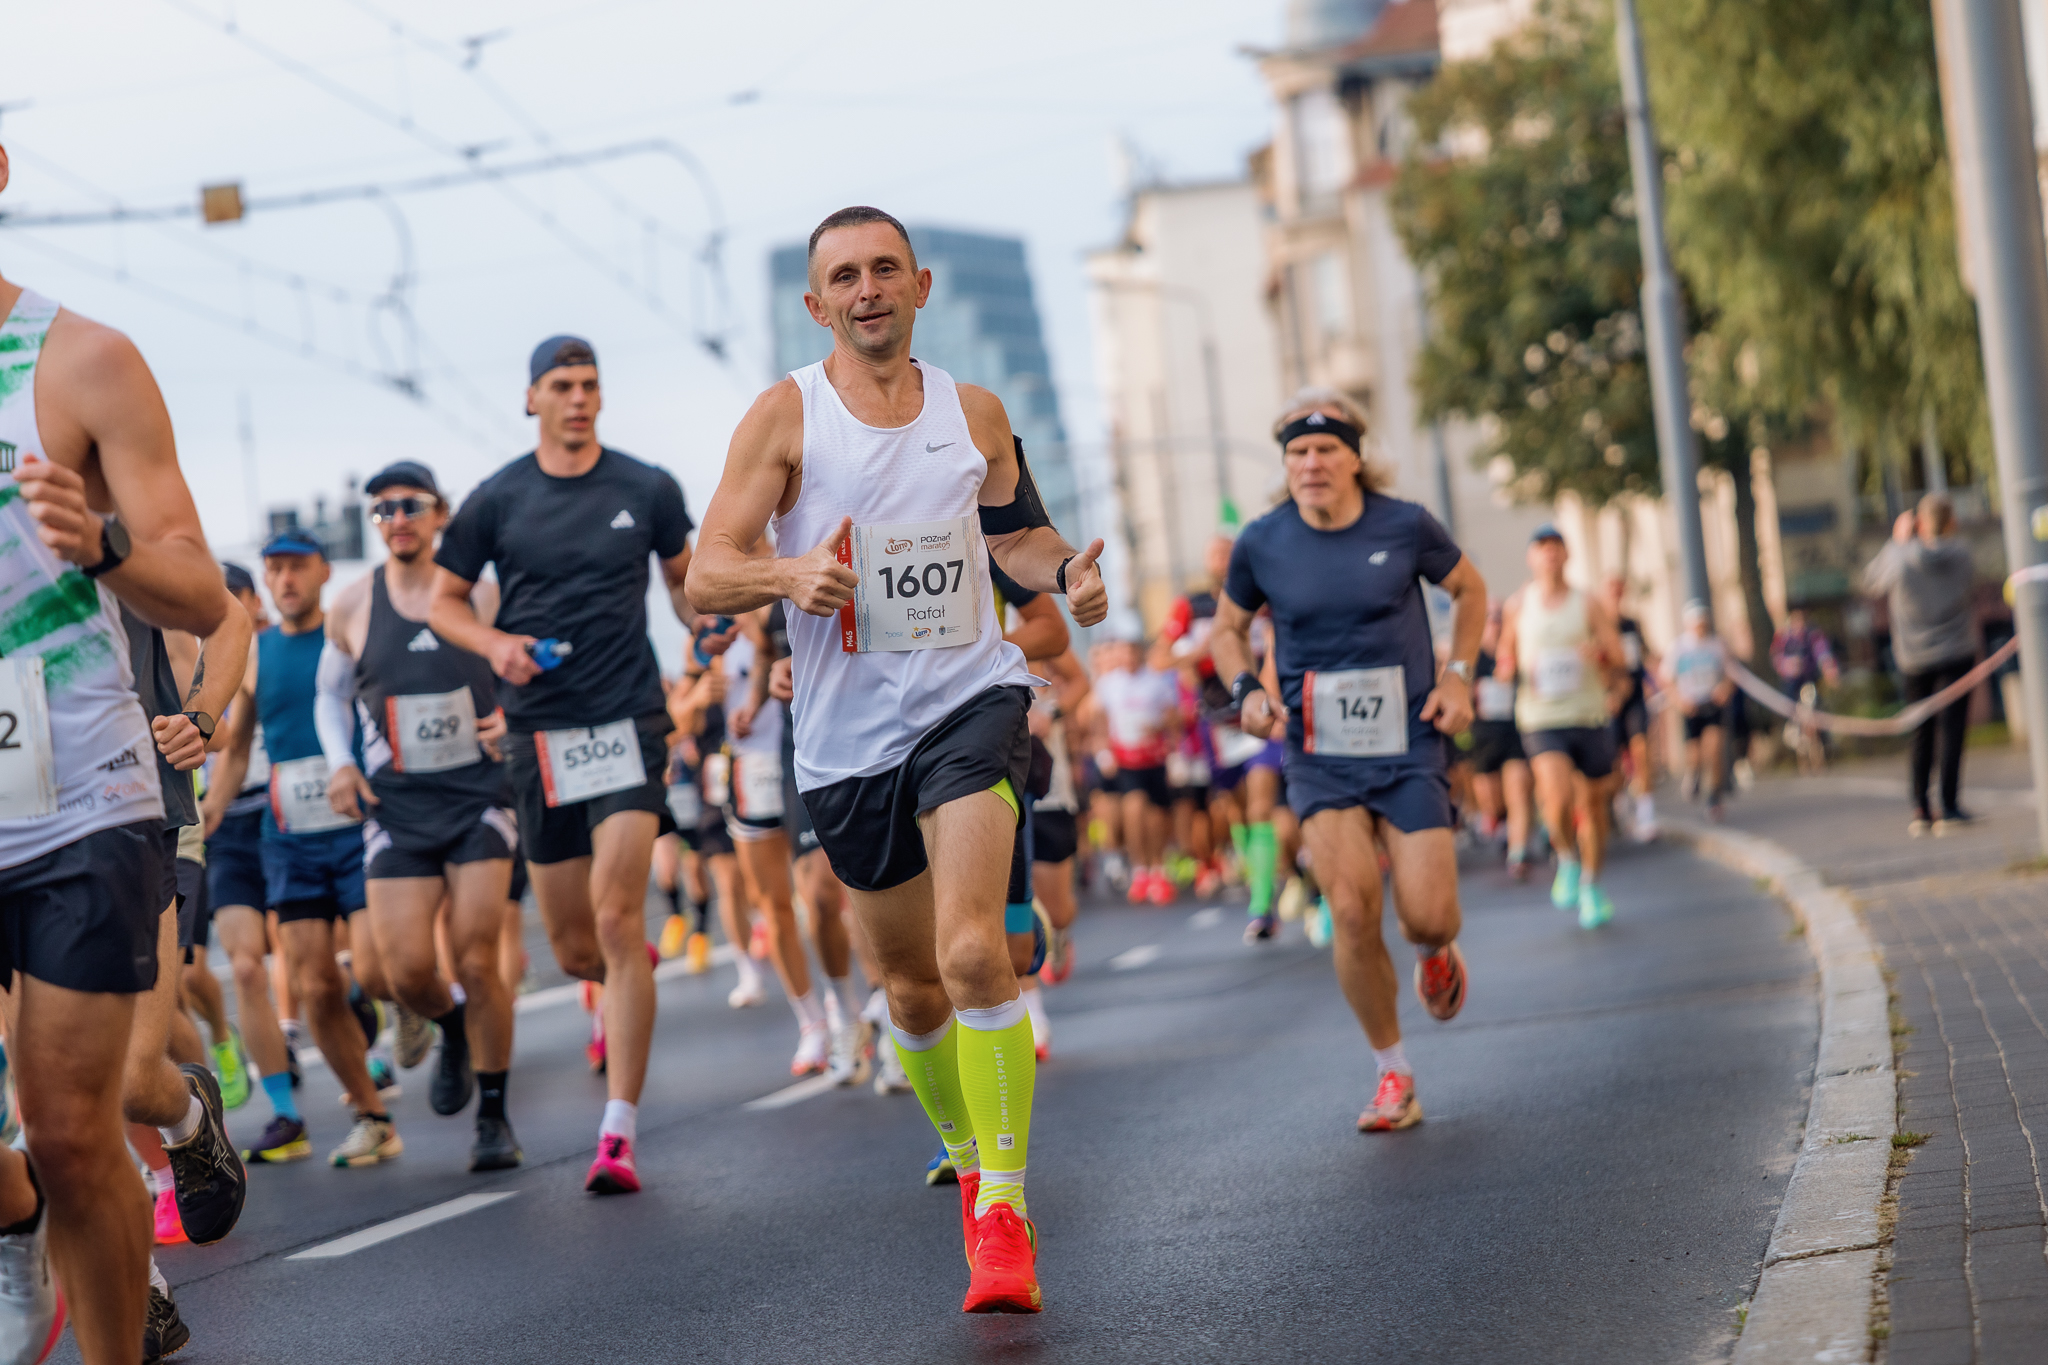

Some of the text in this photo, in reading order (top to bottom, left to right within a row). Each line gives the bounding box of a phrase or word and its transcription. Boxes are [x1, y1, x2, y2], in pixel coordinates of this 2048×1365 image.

[878, 559, 964, 599] 1607
[907, 605, 945, 621] Rafał
[846, 630, 854, 647] M45
[1337, 696, 1384, 720] 147
[417, 714, 460, 741] 629
[564, 737, 626, 769] 5306
[924, 1061, 947, 1119] COMPRESSPORT
[993, 1045, 1010, 1130] COMPRESSPORT
